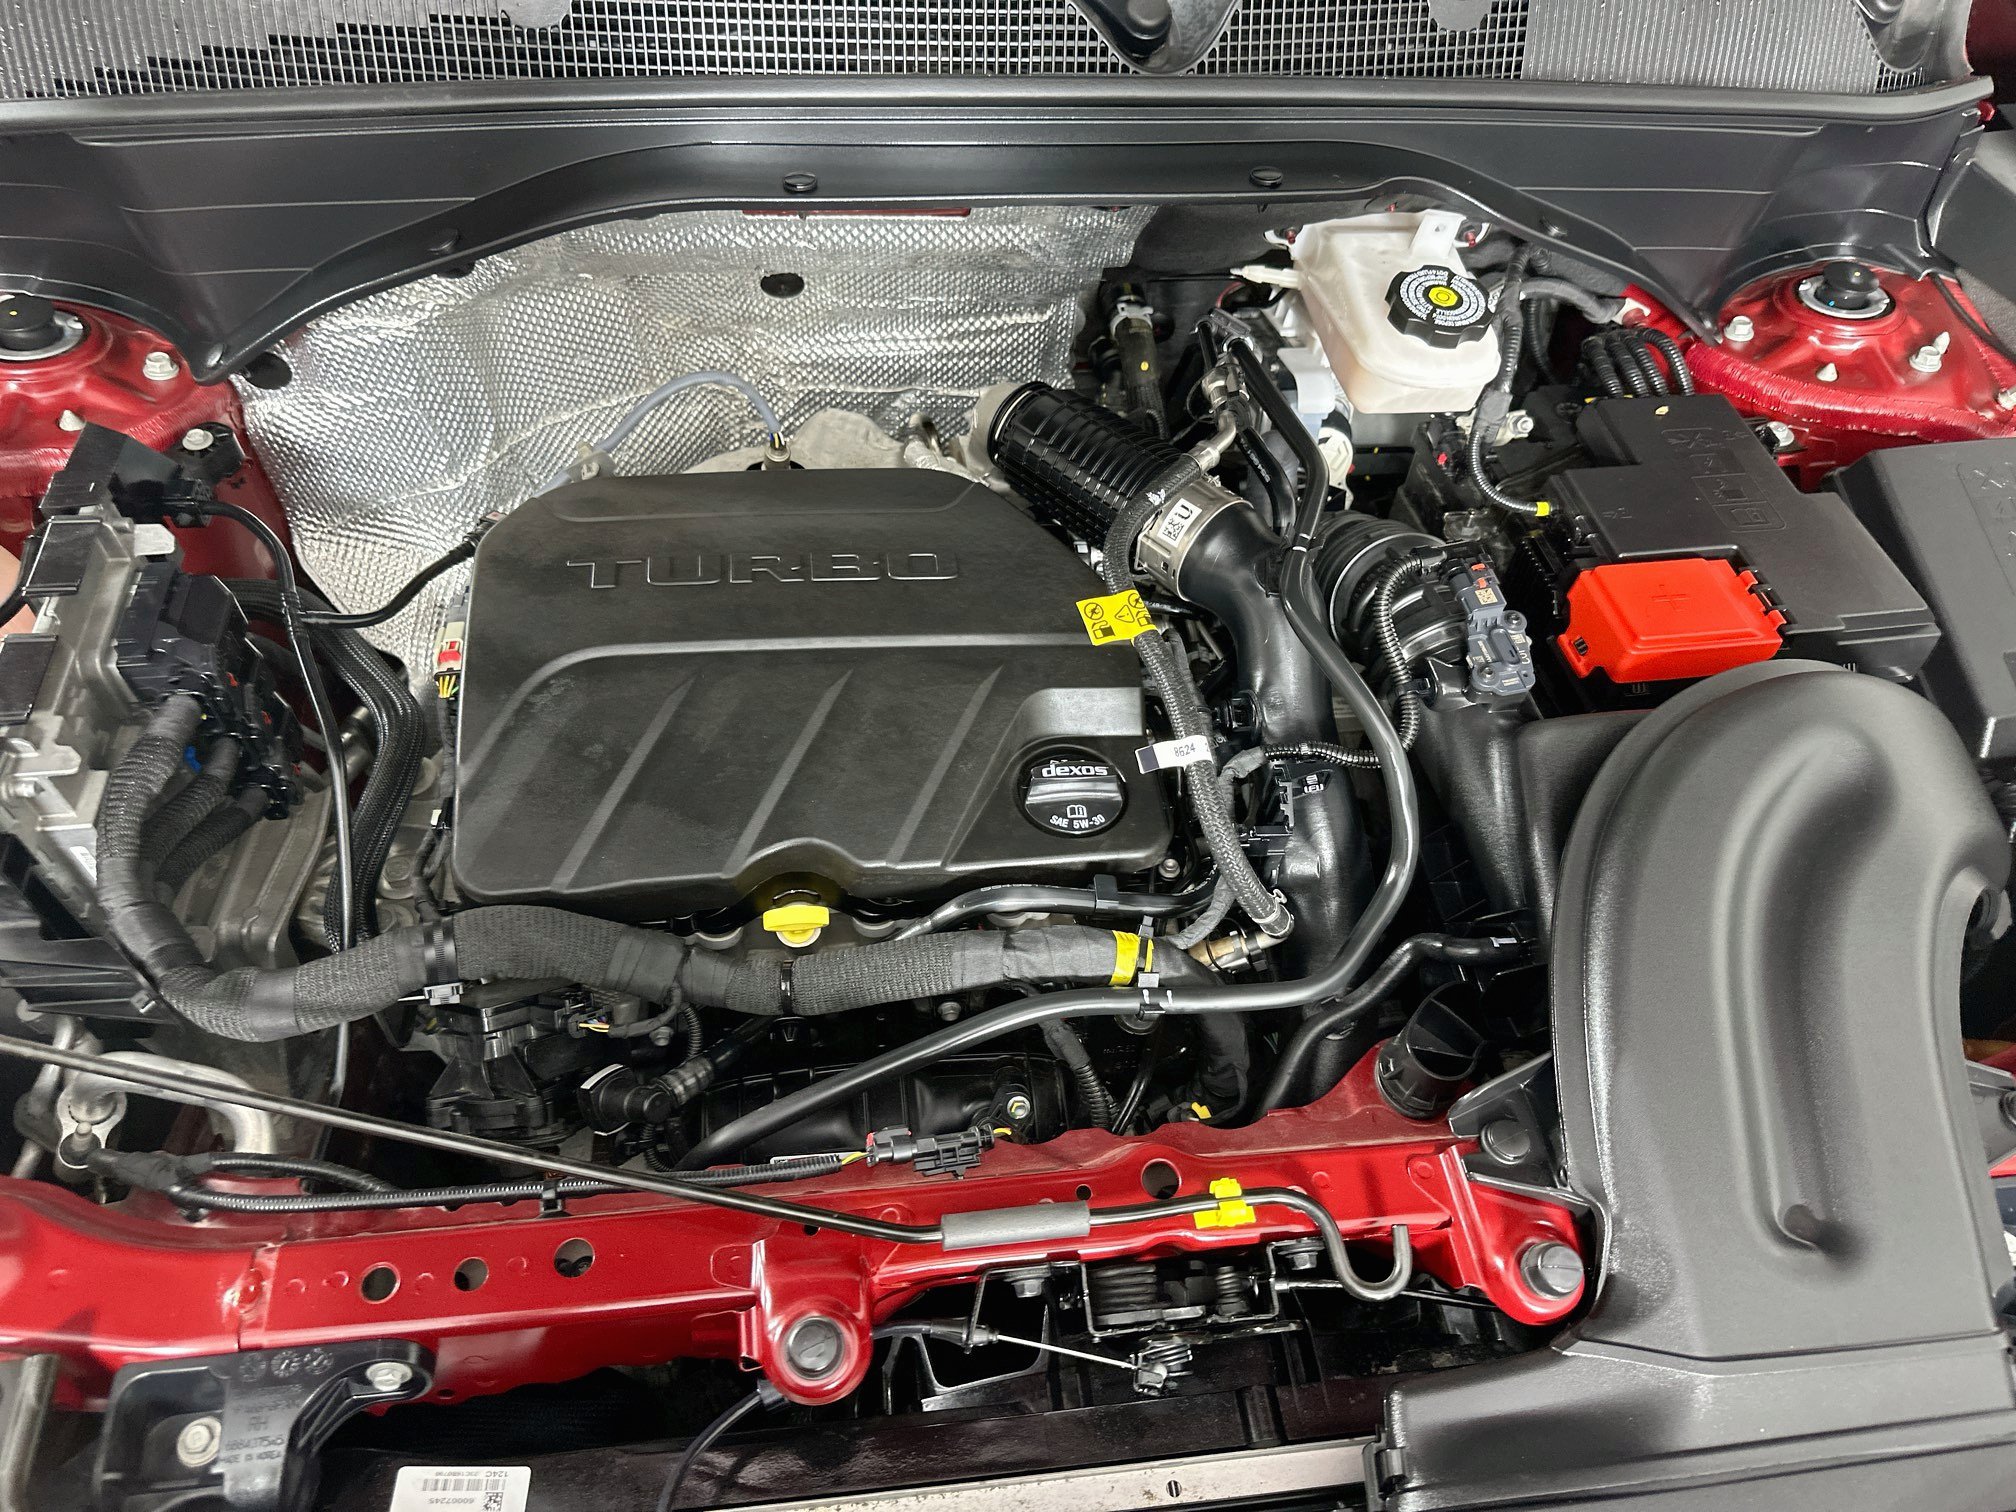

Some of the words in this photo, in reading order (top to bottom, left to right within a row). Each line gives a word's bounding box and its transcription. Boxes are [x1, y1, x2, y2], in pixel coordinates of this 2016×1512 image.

[566, 552, 959, 589] TURBO
[1041, 763, 1109, 778] dexos
[1049, 815, 1070, 828] SAE
[1073, 814, 1106, 829] 5W-30
[485, 1470, 509, 1478] 124C
